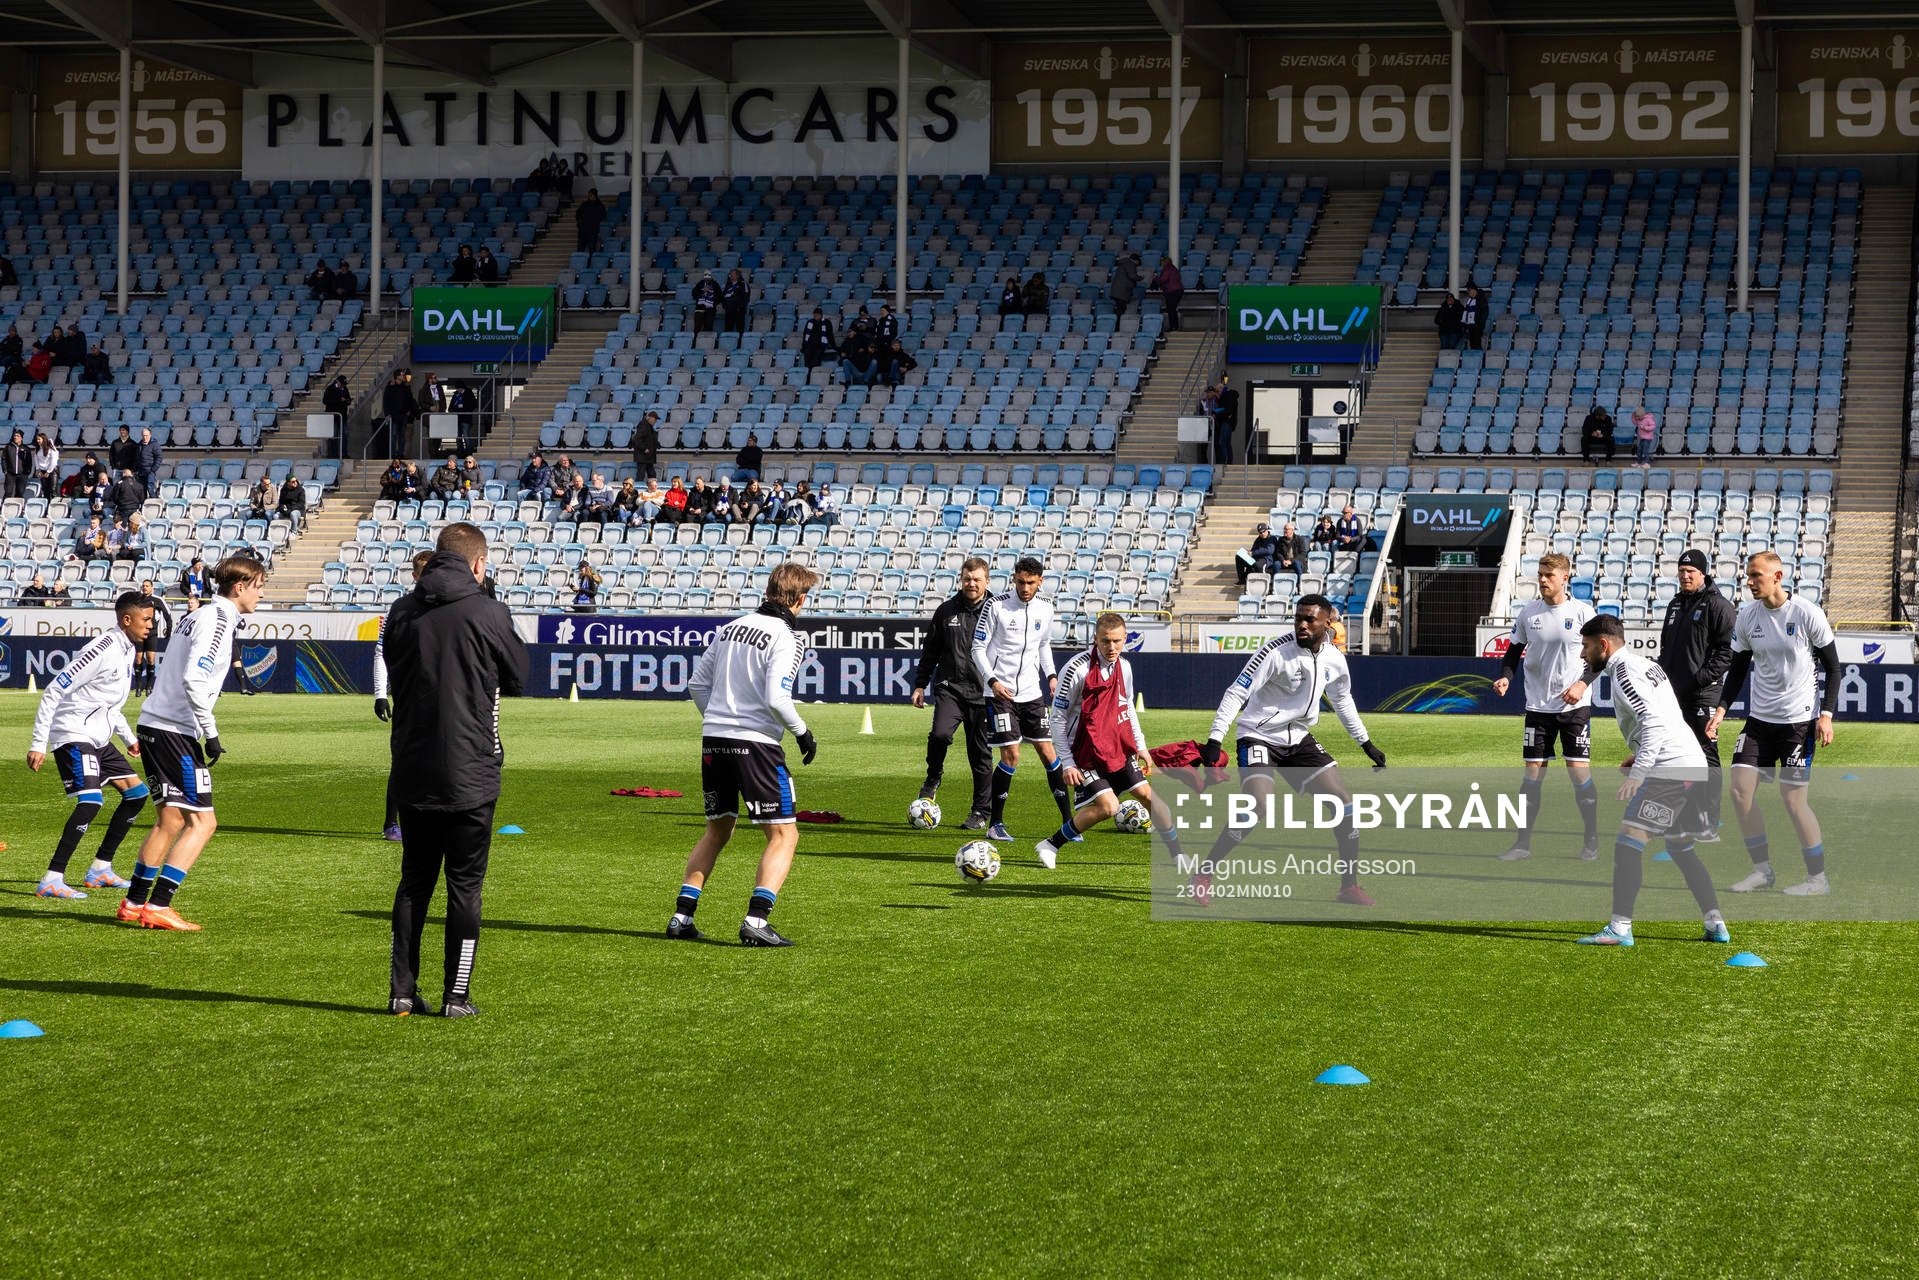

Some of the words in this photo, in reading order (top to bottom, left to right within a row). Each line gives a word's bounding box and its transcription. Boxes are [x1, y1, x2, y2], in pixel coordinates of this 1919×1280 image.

[1024, 58, 1089, 71] SVENSKA
[1122, 54, 1192, 70] MÄSTAE
[1280, 54, 1347, 67] SVENSKA
[1381, 51, 1451, 67] MÄSTARE
[1541, 50, 1609, 64] SVENSKA
[1644, 48, 1717, 63] MÄSTARE
[1810, 46, 1880, 60] SVENSKA
[1016, 86, 1201, 147] 1957
[1266, 83, 1465, 144] 1960
[1529, 79, 1729, 142] 1962
[53, 98, 226, 156] 1956
[423, 308, 516, 332] DAHL
[1240, 307, 1339, 331] DAHL
[1412, 508, 1481, 525] DAHL
[247, 623, 313, 640] 2023
[720, 625, 772, 651] SIRIUS
[894, 626, 928, 650] st
[840, 657, 931, 696] RIK
